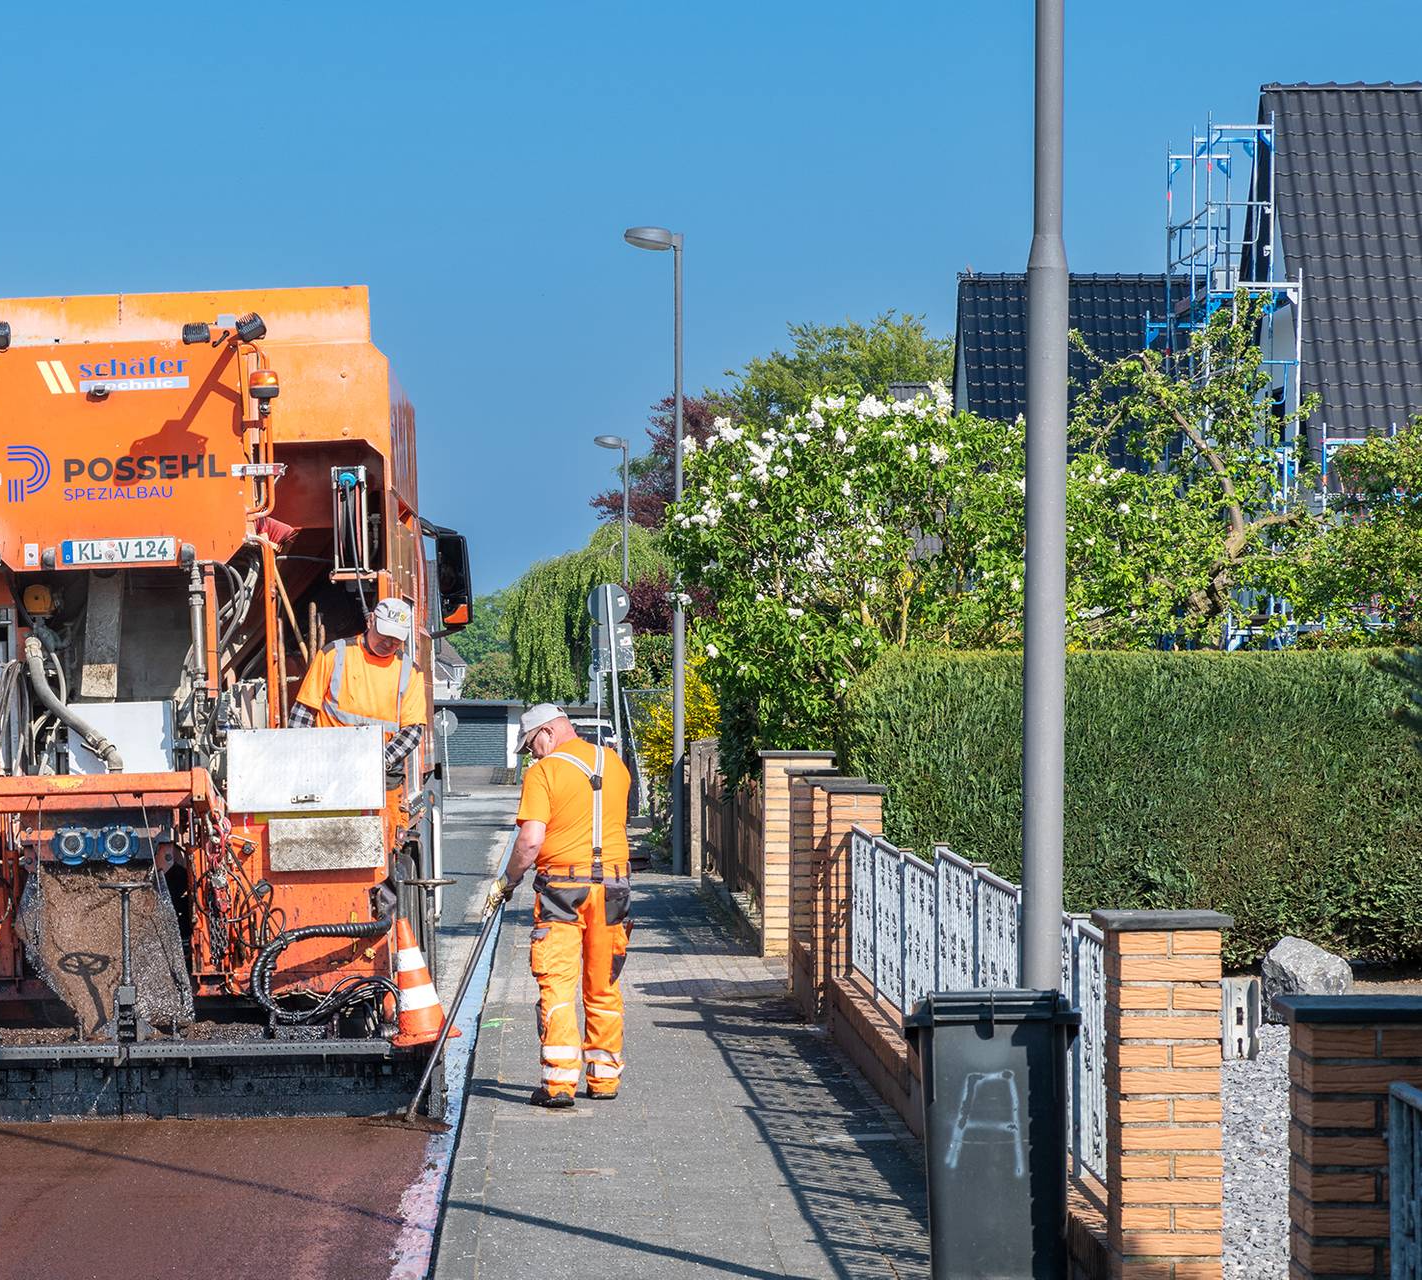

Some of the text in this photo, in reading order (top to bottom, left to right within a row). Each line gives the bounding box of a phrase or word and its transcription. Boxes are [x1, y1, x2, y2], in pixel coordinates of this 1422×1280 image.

[79, 356, 187, 378] schäfer
[95, 378, 174, 391] echnic
[64, 454, 227, 483] POSSEHL
[64, 486, 174, 501] SPEZIALBAU
[78, 542, 103, 561] KL
[118, 541, 130, 559] V
[134, 540, 168, 558] 124
[945, 1068, 1024, 1177] A
